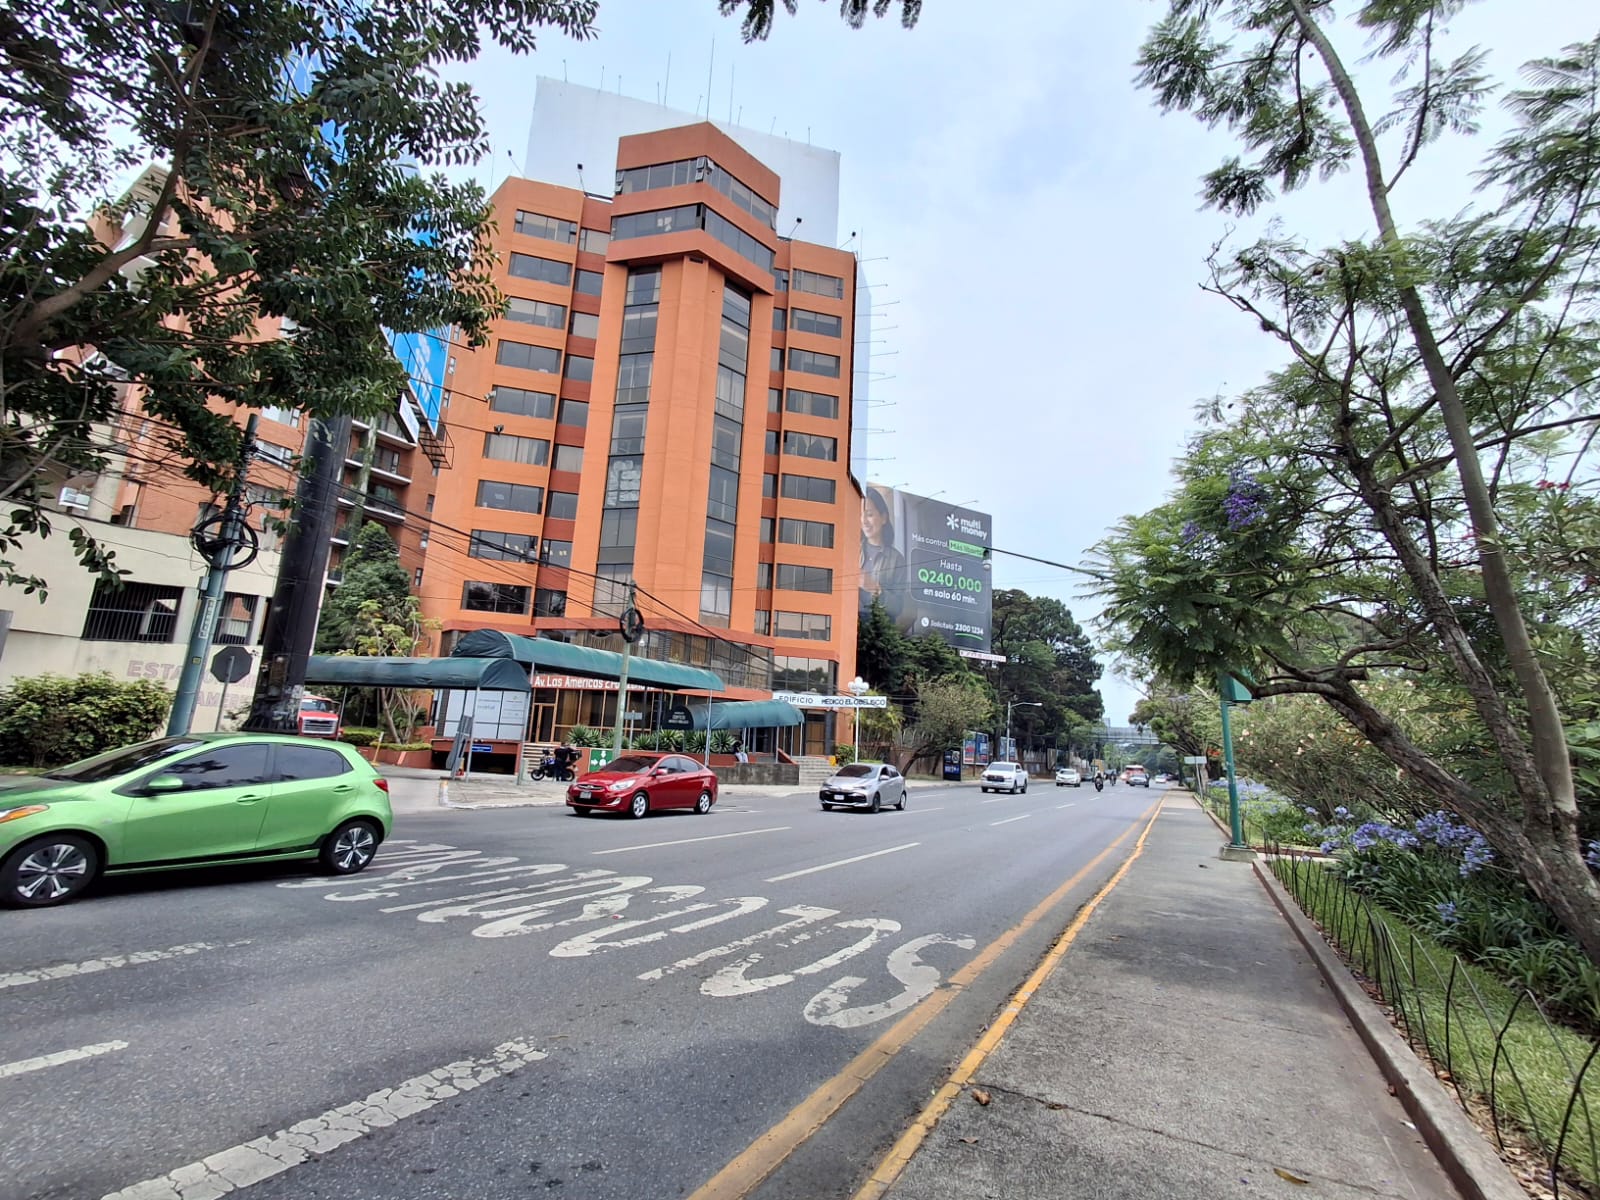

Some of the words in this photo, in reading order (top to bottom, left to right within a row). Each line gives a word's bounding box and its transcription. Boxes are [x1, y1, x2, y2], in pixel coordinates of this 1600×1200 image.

[960, 518, 981, 530] multi
[961, 526, 988, 541] money
[940, 559, 963, 572] Hasta
[918, 568, 982, 593] Q240,000
[923, 588, 934, 597] en
[934, 590, 951, 600] solo
[951, 592, 962, 601] 60
[546, 675, 562, 687] Las
[778, 695, 814, 704] EDIFICIO
